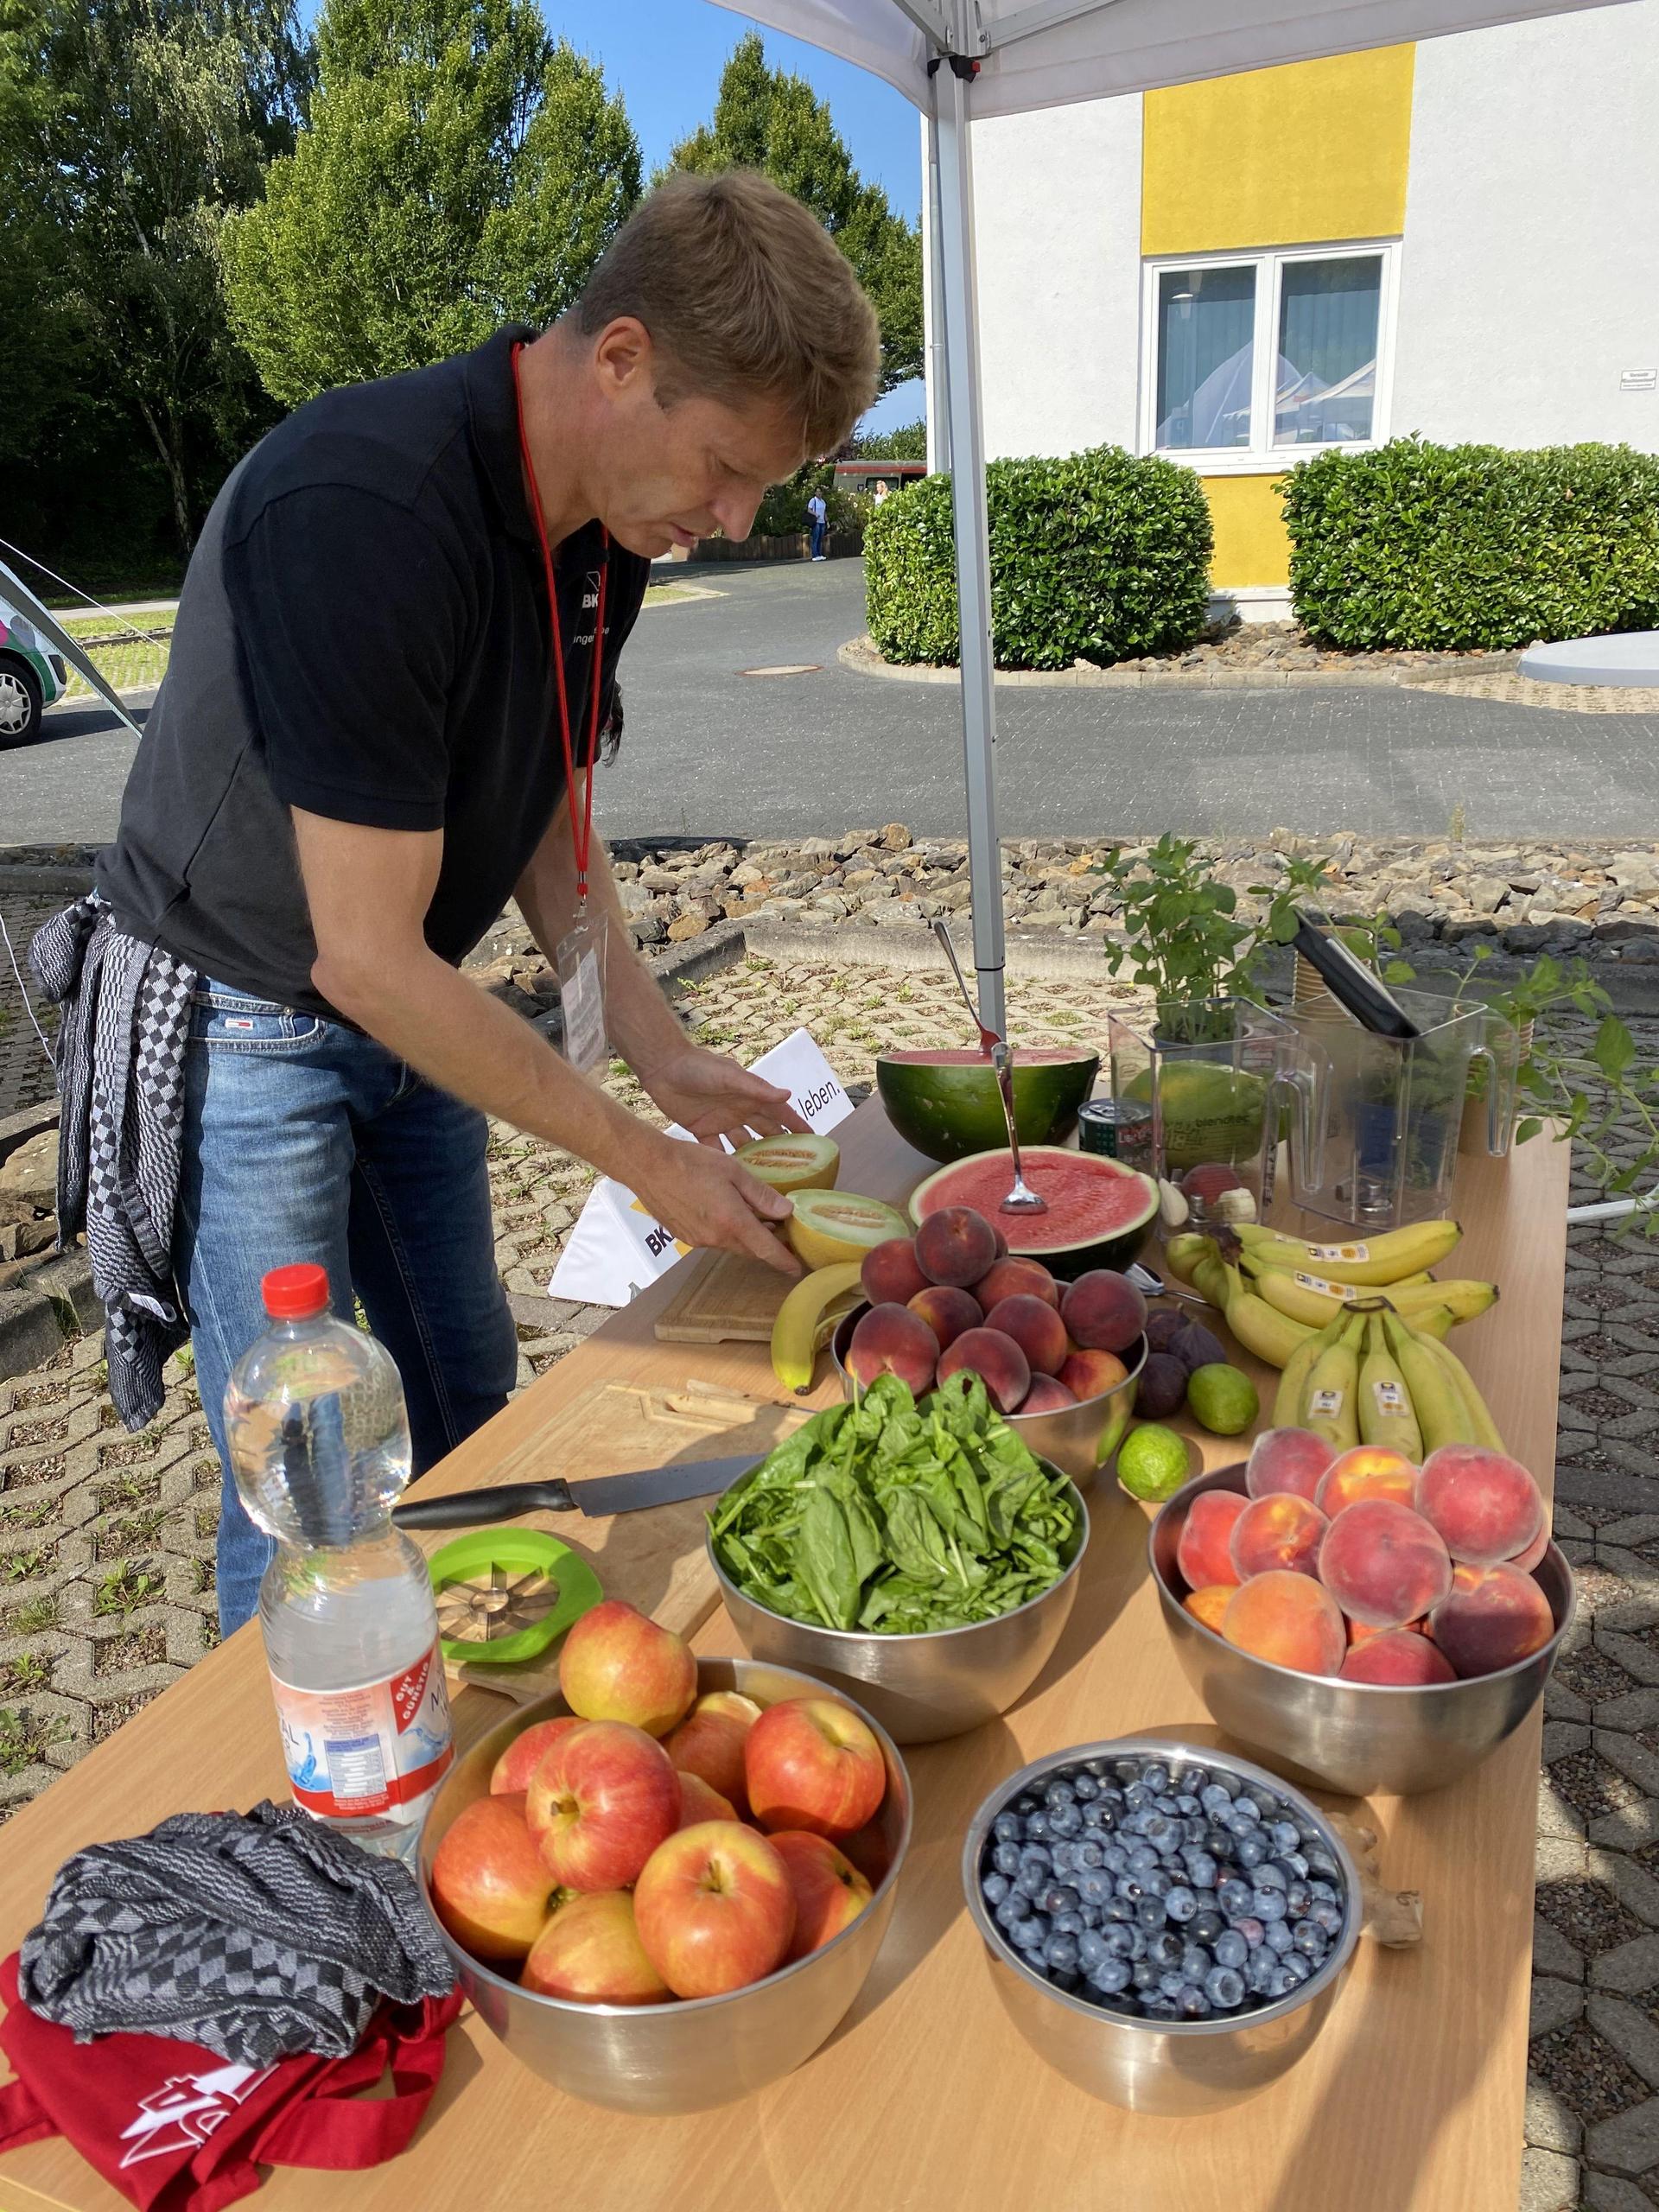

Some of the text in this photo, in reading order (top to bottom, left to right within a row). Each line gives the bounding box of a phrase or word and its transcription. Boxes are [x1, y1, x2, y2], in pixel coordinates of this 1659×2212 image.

[582, 594, 599, 608] BK
[798, 1081, 841, 1121] leben.
[645, 1224, 674, 1257] BK
[396, 1675, 412, 1702] GUT
